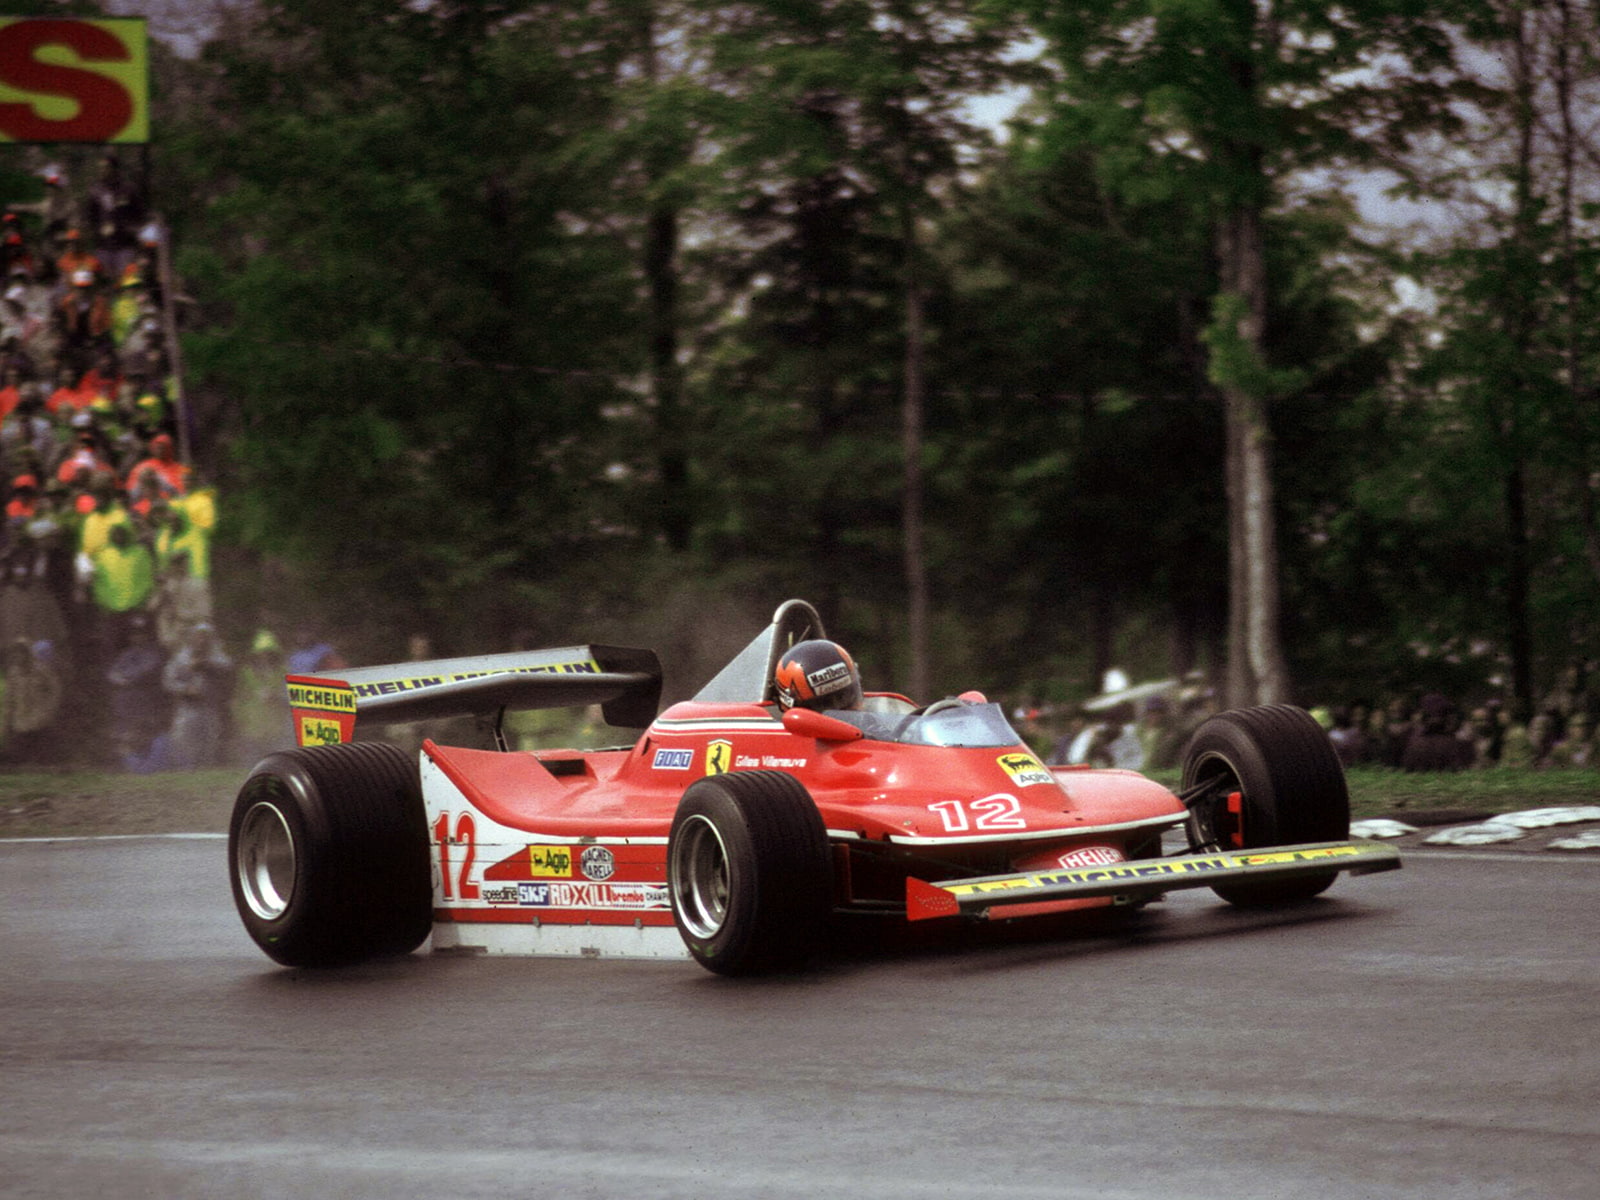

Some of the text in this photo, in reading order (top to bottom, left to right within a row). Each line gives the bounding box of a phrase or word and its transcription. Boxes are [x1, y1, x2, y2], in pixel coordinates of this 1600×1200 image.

[0, 19, 134, 142] S
[810, 666, 849, 685] Marlboro
[289, 687, 353, 708] MICHELIN
[655, 751, 692, 767] FIAT
[1019, 773, 1051, 783] Agip
[927, 793, 1027, 832] 12
[433, 810, 481, 903] 12
[545, 848, 570, 874] Agip
[1058, 846, 1124, 868] HEUER
[519, 884, 549, 903] SKF
